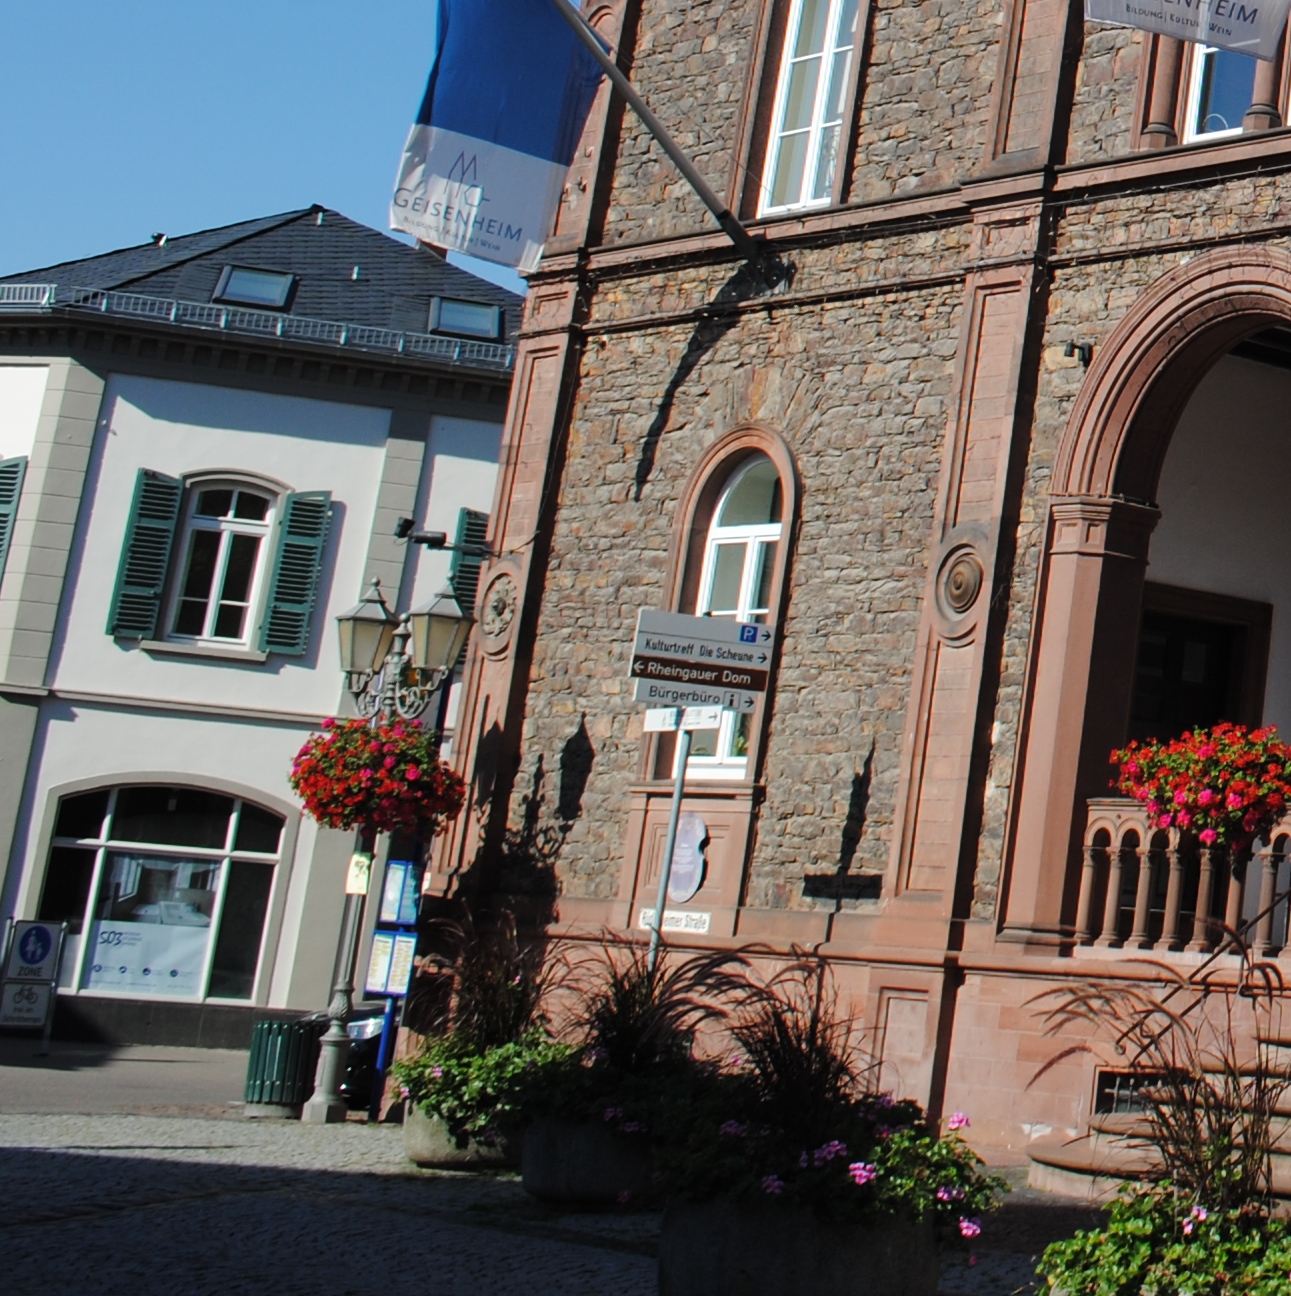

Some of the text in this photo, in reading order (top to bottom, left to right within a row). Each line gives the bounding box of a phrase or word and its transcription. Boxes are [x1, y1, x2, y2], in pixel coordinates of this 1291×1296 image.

[393, 187, 523, 242] GEISENHEIM
[743, 626, 755, 641] P
[645, 638, 695, 655] Kulturtreff
[699, 645, 713, 658] Die
[647, 661, 752, 685] Rheingauer Dom
[648, 685, 721, 703] Bürgerbüro
[17, 966, 44, 977] ZONE
